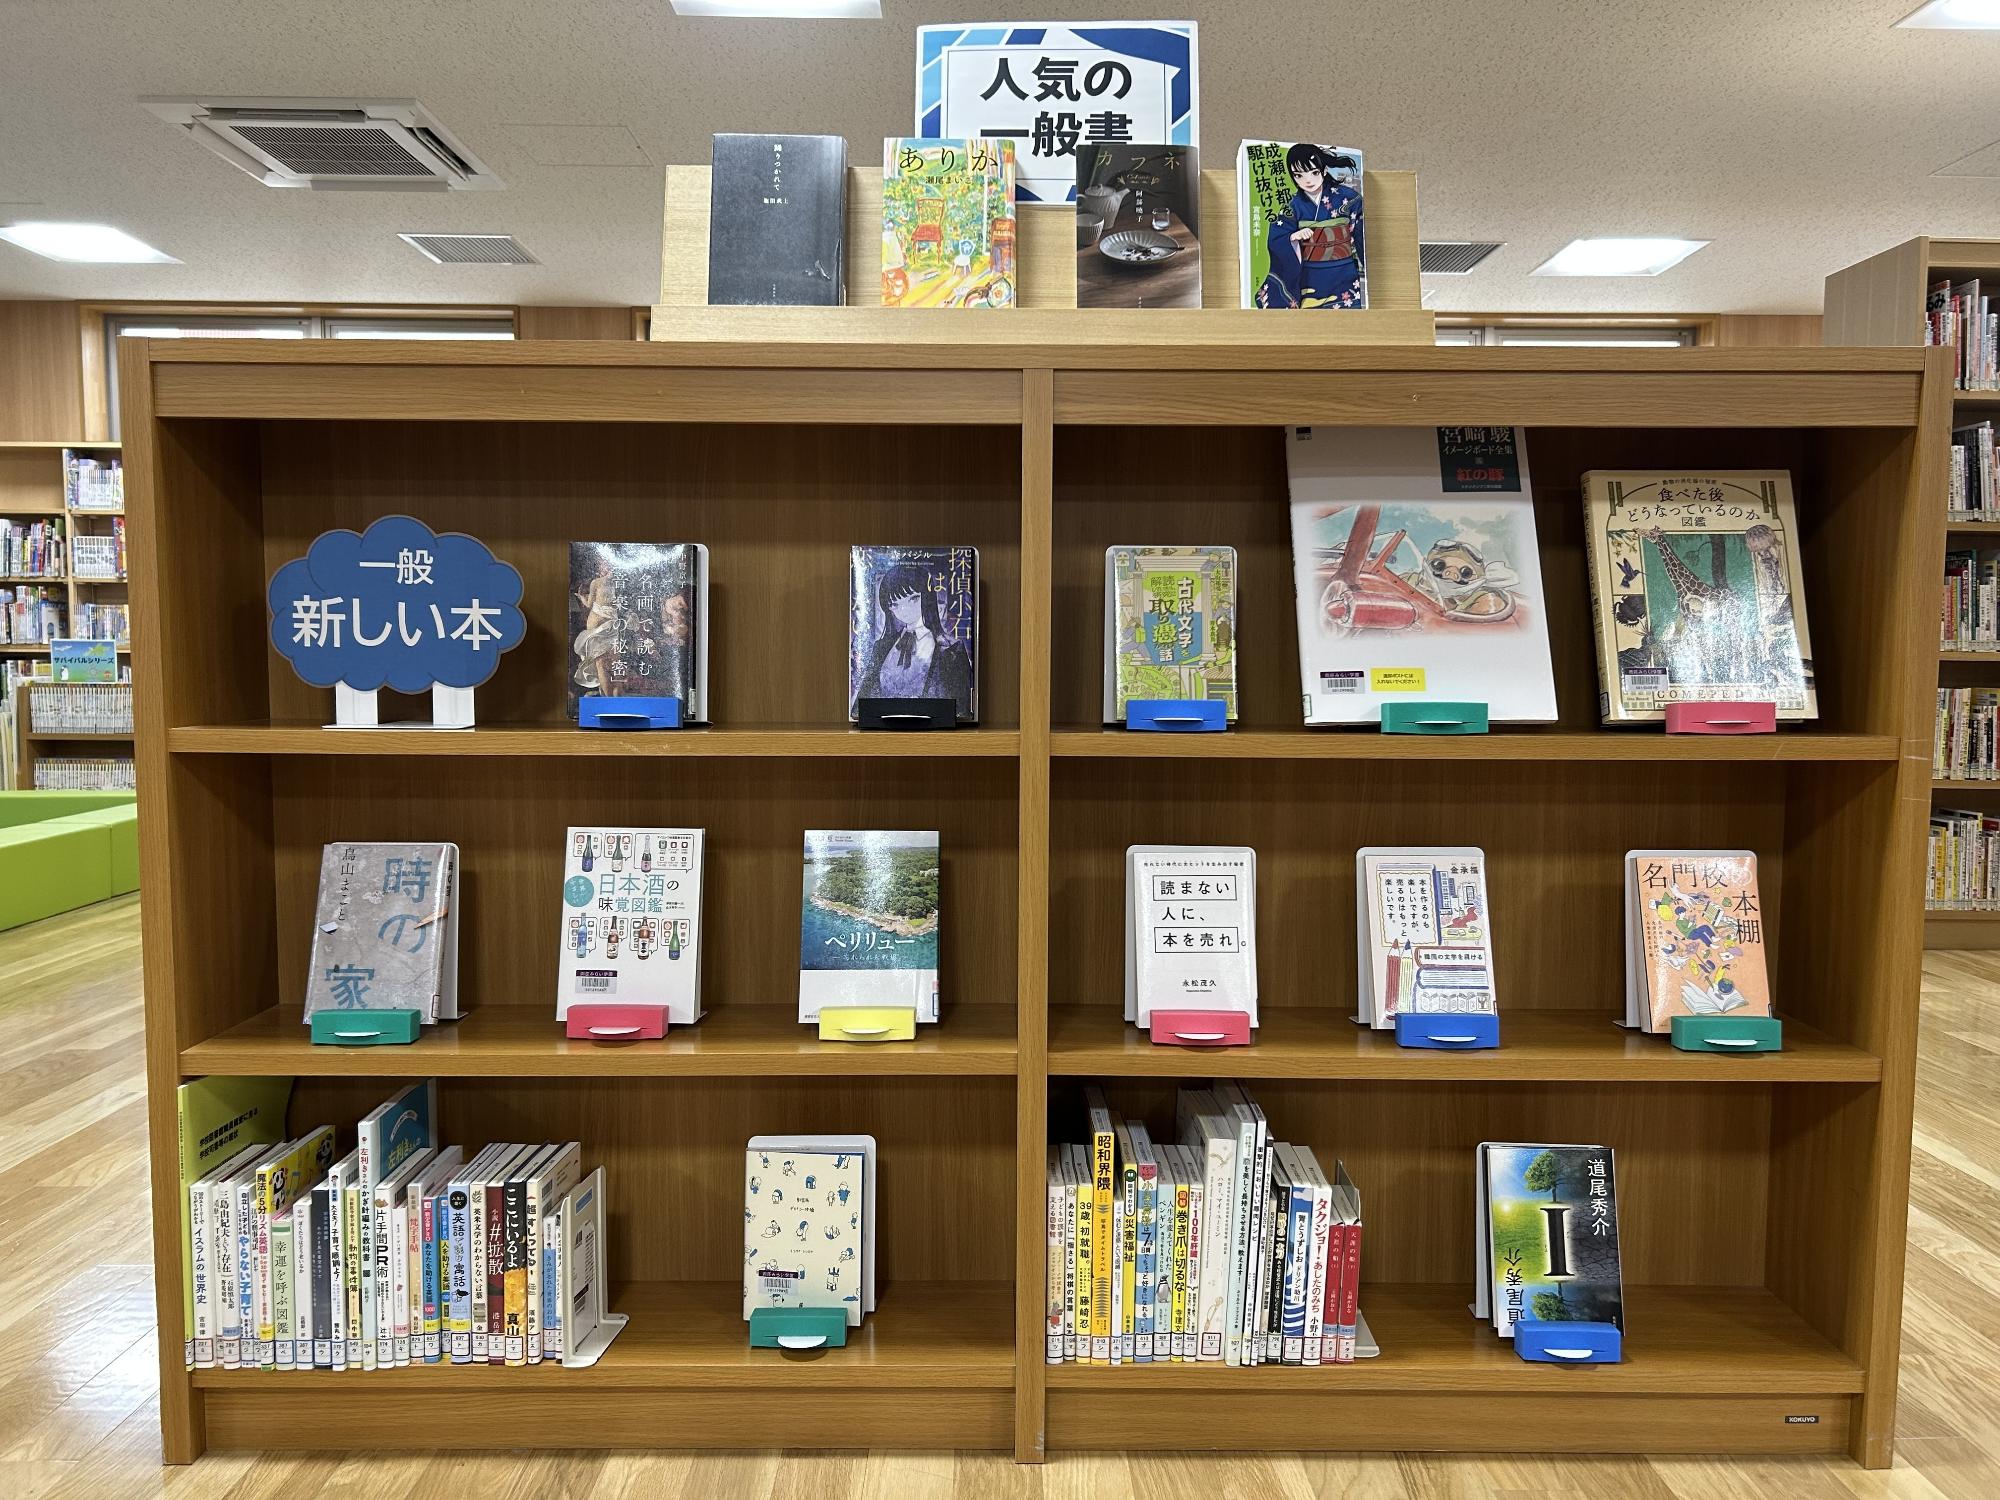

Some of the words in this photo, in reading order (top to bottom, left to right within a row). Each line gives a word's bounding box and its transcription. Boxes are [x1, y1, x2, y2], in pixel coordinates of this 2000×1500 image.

[980, 56, 1132, 102] 人気の
[900, 148, 998, 172] ありか
[980, 110, 1133, 157] 一般書
[1098, 151, 1180, 171] カフネ
[1247, 145, 1278, 223] 駆け抜ける
[1265, 142, 1294, 217] 成瀬は都を
[1628, 504, 1761, 522] どうなっているのか
[1658, 488, 1725, 502] 食べた後
[1682, 517, 1706, 527] 図鑑
[360, 548, 434, 585] 一般
[949, 548, 972, 640] 探偵小石
[292, 594, 502, 651] 新しい本
[638, 573, 654, 676] 名画で読む
[598, 897, 663, 913] 味覚図鑑
[599, 873, 680, 897] 日本酒の
[1160, 880, 1230, 895] 読まない
[1384, 878, 1397, 923] 楽しいです。
[1395, 878, 1408, 937] 売るのはもっと
[1407, 878, 1420, 933] 楽しいですが、
[1418, 878, 1430, 929] 本を作るのも
[1161, 906, 1206, 921] 人に、
[1162, 932, 1247, 947] 本を売れ。
[1732, 890, 1762, 944] 本棚
[825, 931, 916, 953] ペリリュー
[1097, 1135, 1111, 1191] 昭和界隈
[1587, 1158, 1611, 1236] 道尾秀介
[375, 1209, 389, 1278] 片手間PR術
[473, 1208, 483, 1299] 英米文学のわからない言葉
[488, 1223, 505, 1275] #拡散
[506, 1188, 519, 1268] ここにいるよ
[1079, 1202, 1092, 1264] 39歳、初就職。
[1124, 1218, 1135, 1263] 災害福祉
[195, 1228, 207, 1304] イスラムの世界史
[240, 1236, 252, 1316] やらない子育て
[1174, 1209, 1188, 1303] 巻き爪は切るな！
[275, 1241, 290, 1334] 幸運を呼ぶ図鑑
